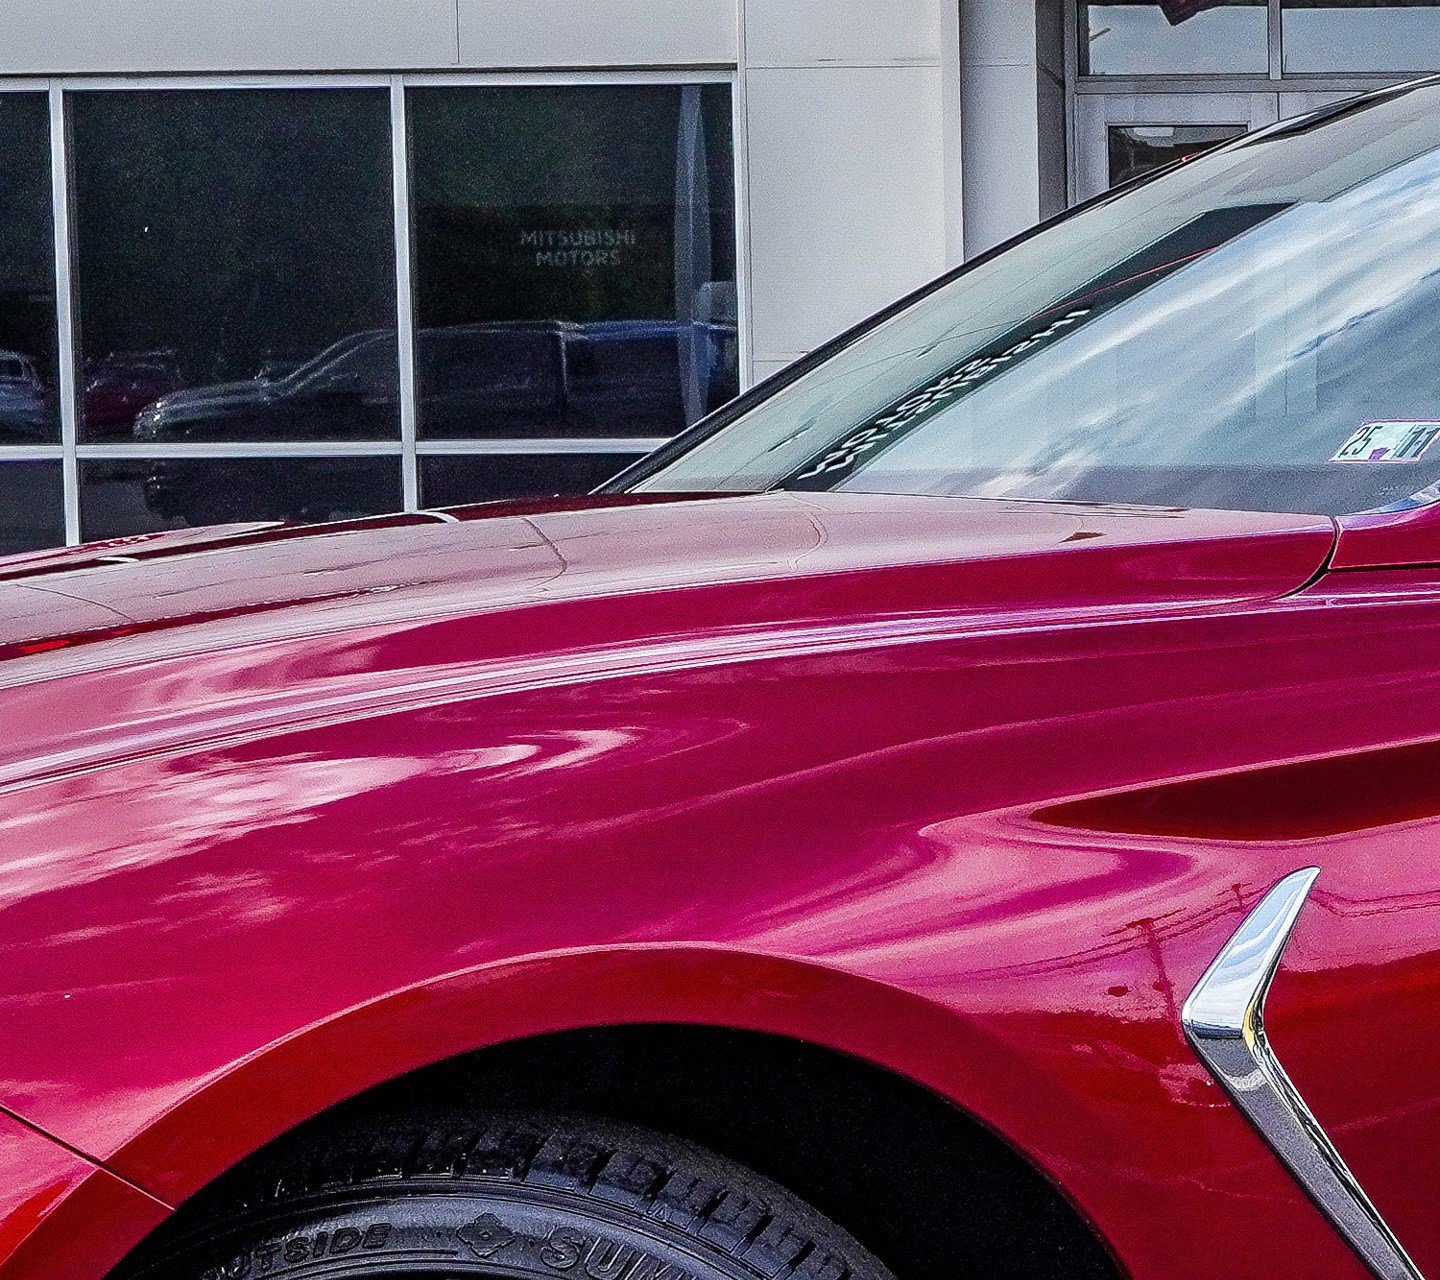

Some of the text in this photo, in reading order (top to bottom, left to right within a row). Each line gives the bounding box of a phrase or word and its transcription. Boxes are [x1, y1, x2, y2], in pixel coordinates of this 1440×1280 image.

[520, 229, 637, 246] MITSUBISHI
[536, 249, 621, 266] MOTORS
[1337, 425, 1383, 458] 25
